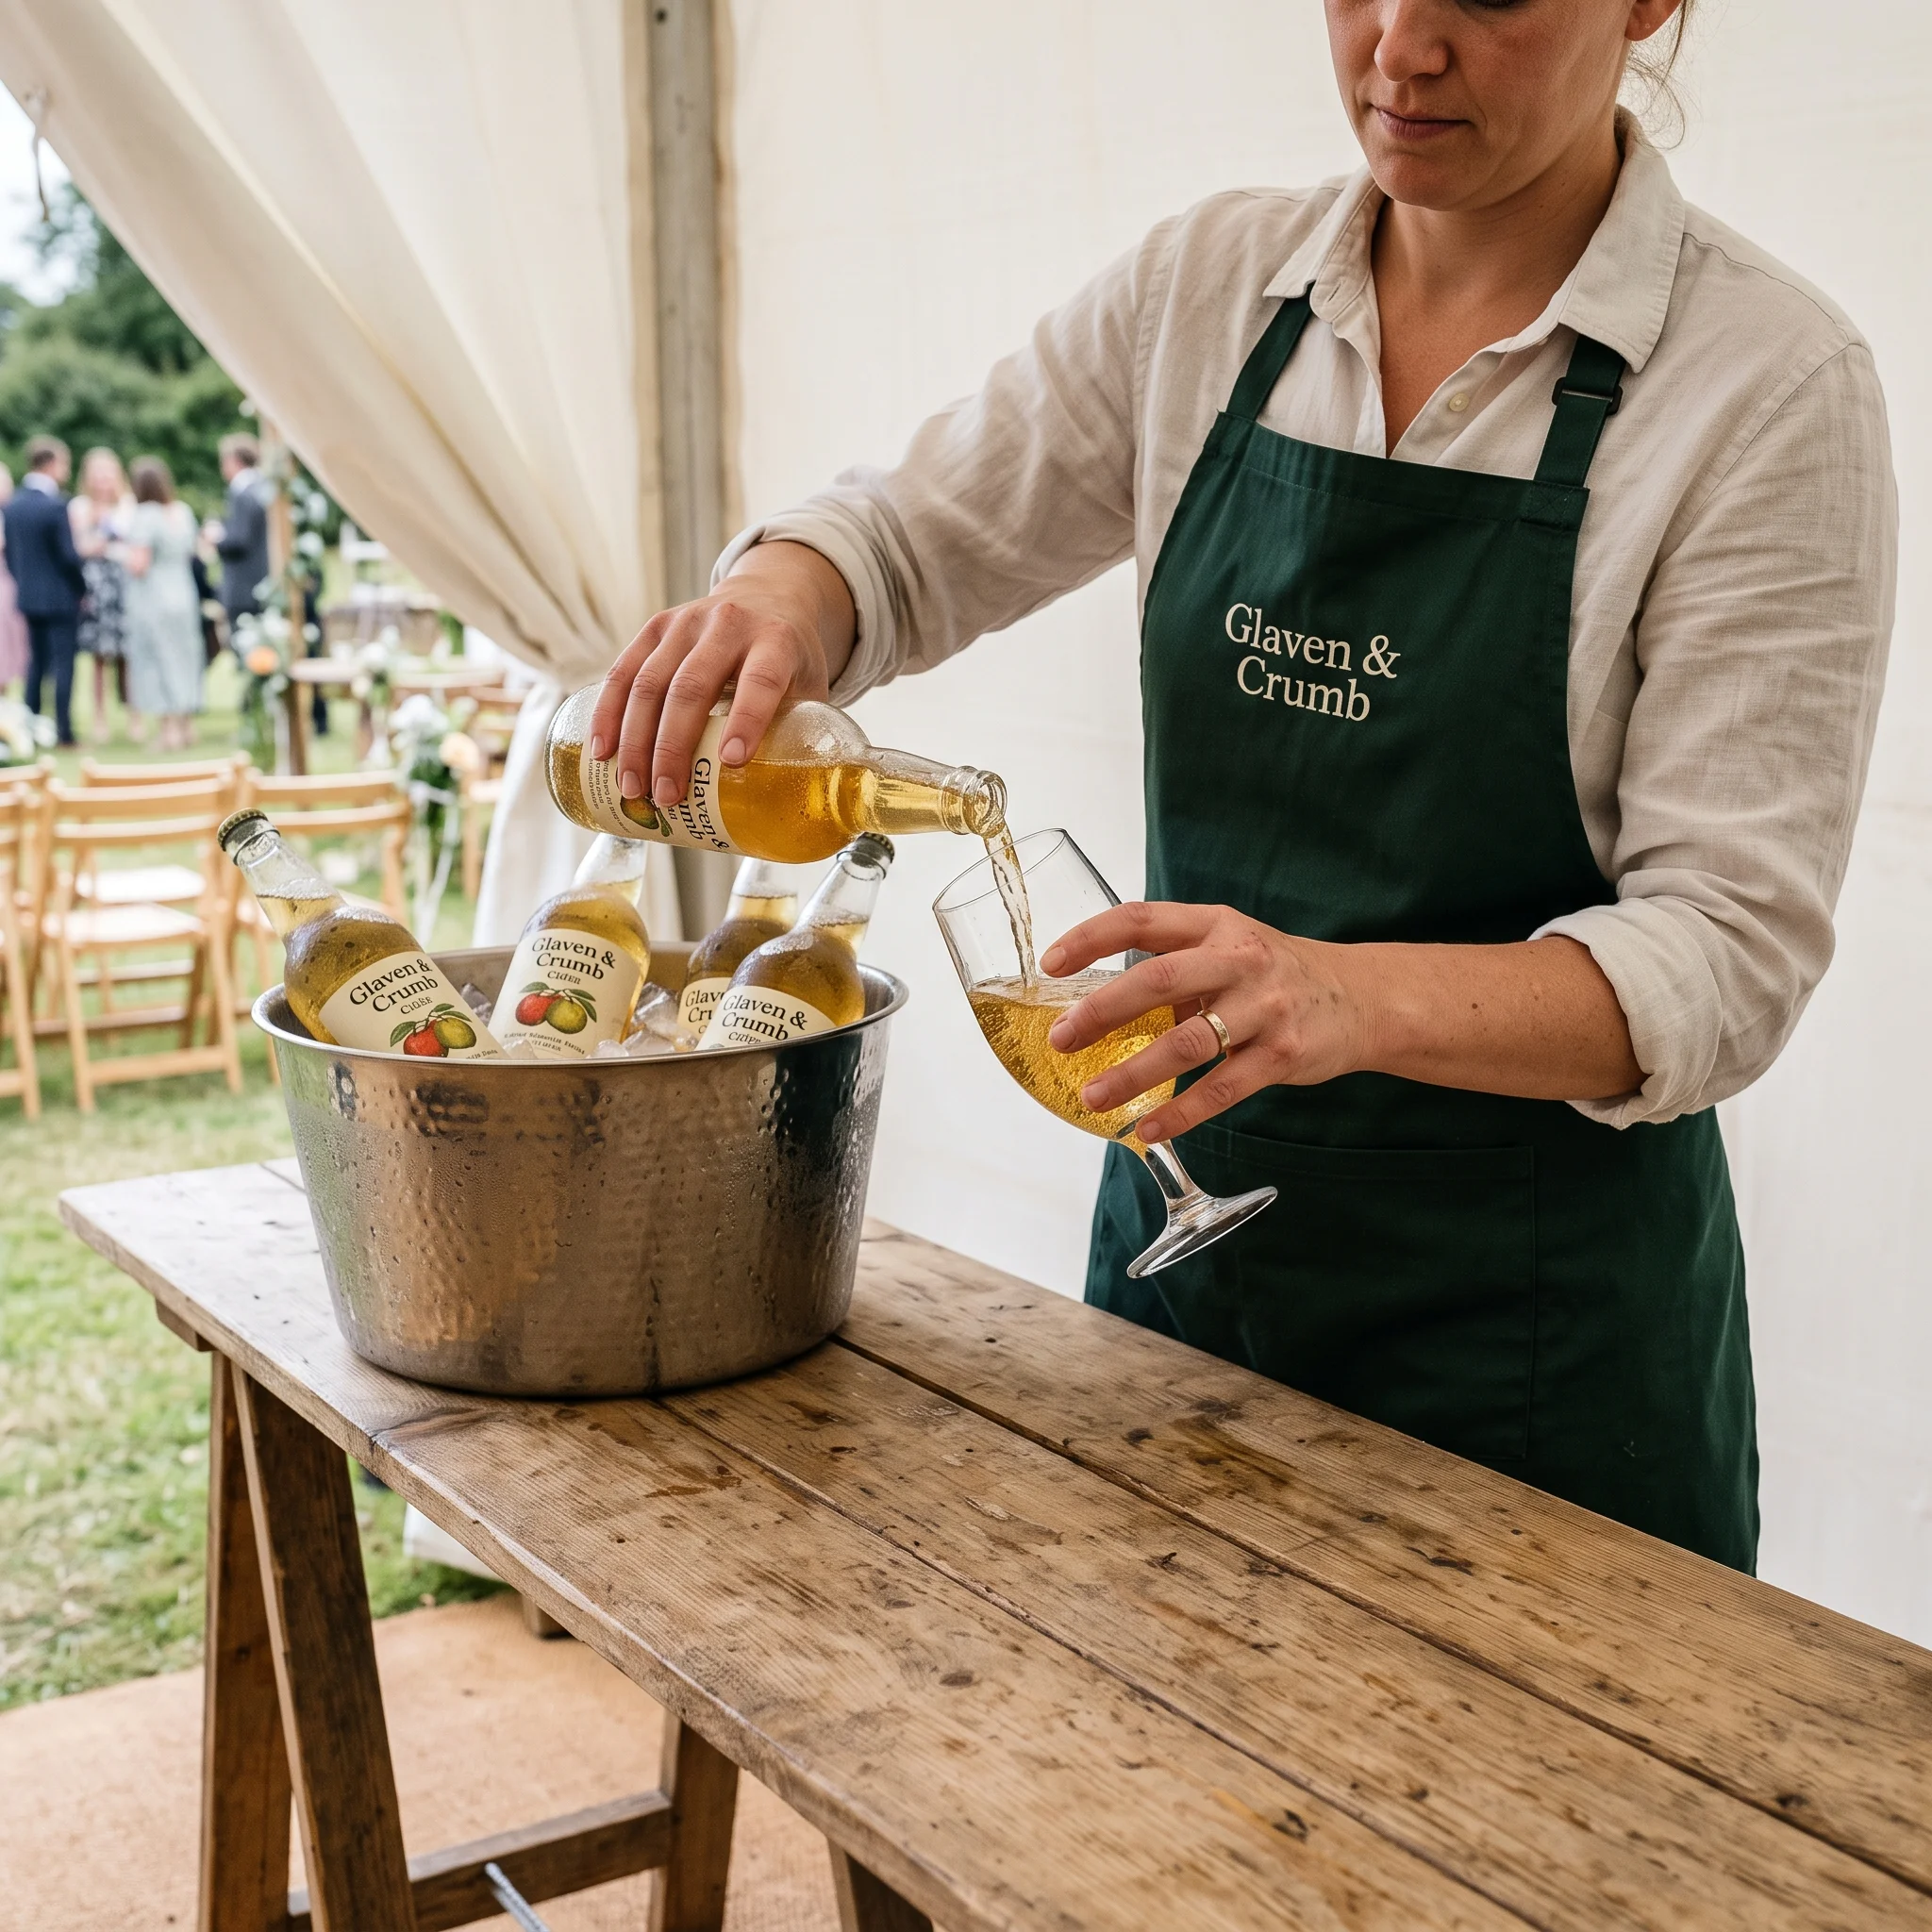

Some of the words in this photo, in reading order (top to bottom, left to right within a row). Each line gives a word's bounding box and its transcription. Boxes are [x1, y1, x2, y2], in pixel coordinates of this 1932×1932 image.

[1224, 603, 1353, 672] Glaven
[1362, 635, 1402, 679] &
[1237, 655, 1371, 722] Crumb
[694, 758, 716, 836] Glaven
[711, 838, 730, 850] &
[531, 937, 597, 959] Glaven
[601, 950, 616, 969] &
[536, 952, 605, 980] Crumb
[349, 963, 418, 1006] Glaven
[416, 958, 433, 973] &
[372, 974, 439, 1012] Crumb
[685, 990, 724, 1008] Glav
[722, 1011, 789, 1041] Crumb
[723, 994, 787, 1021] Glaven
[790, 1010, 808, 1031] &
